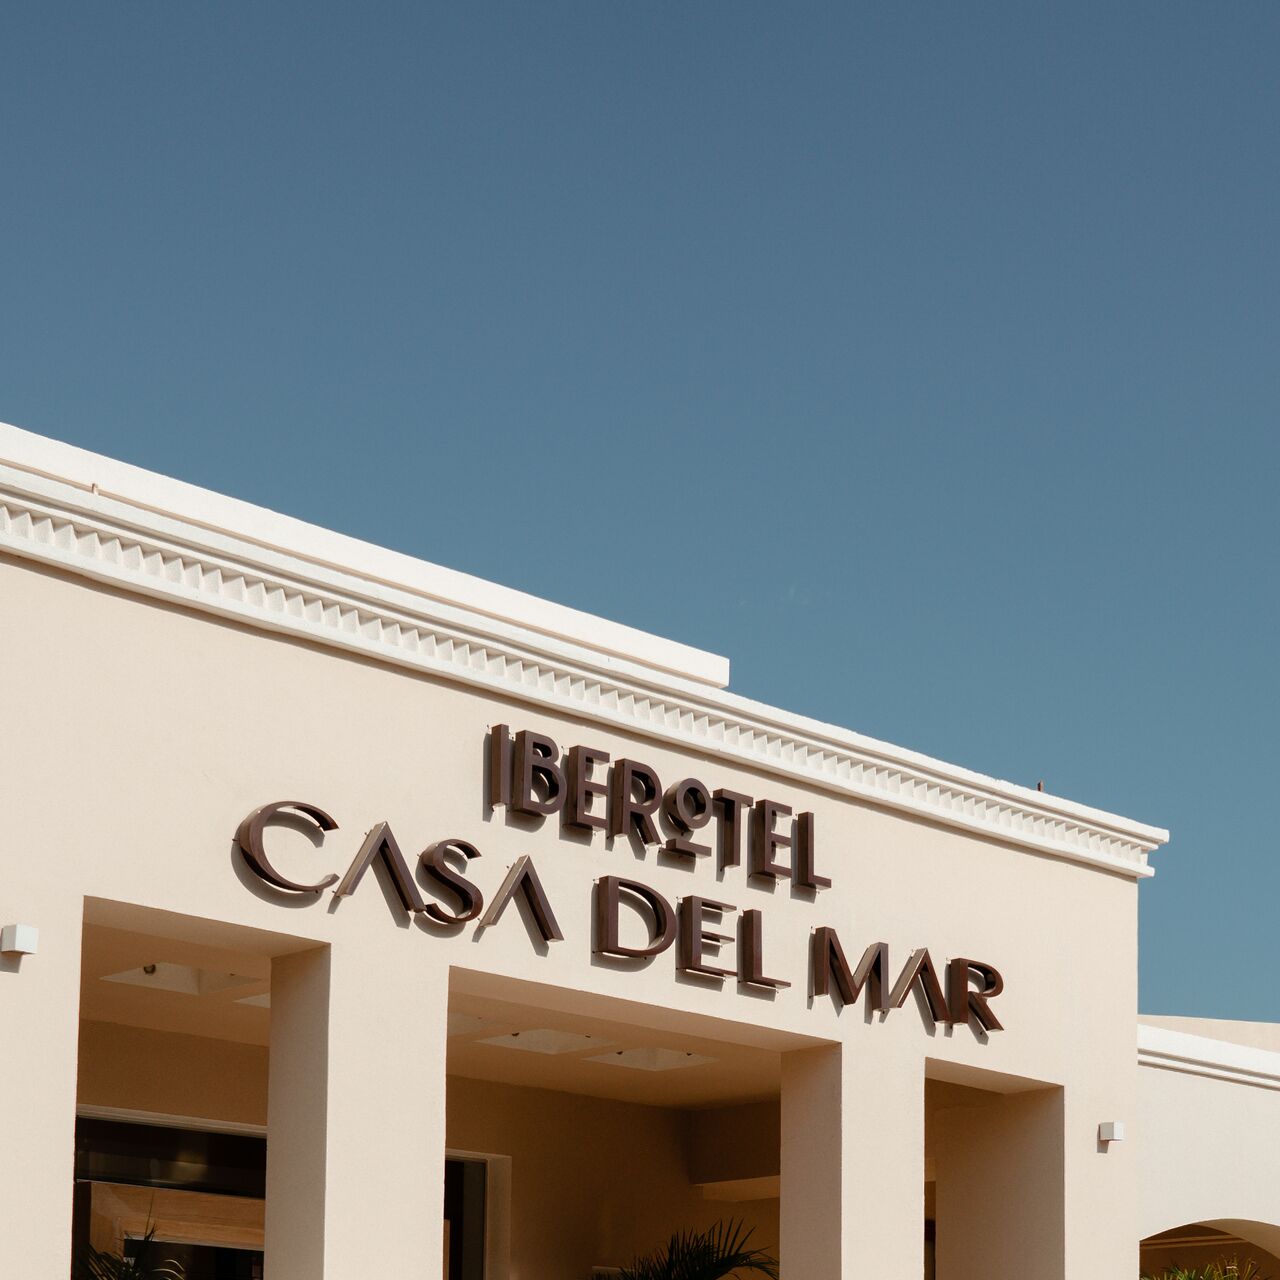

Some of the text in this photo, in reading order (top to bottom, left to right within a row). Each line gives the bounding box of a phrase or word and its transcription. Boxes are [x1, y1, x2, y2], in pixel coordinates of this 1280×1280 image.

[491, 723, 832, 893] IBEROTEL
[233, 800, 1006, 1034] CASA DEL MAR
